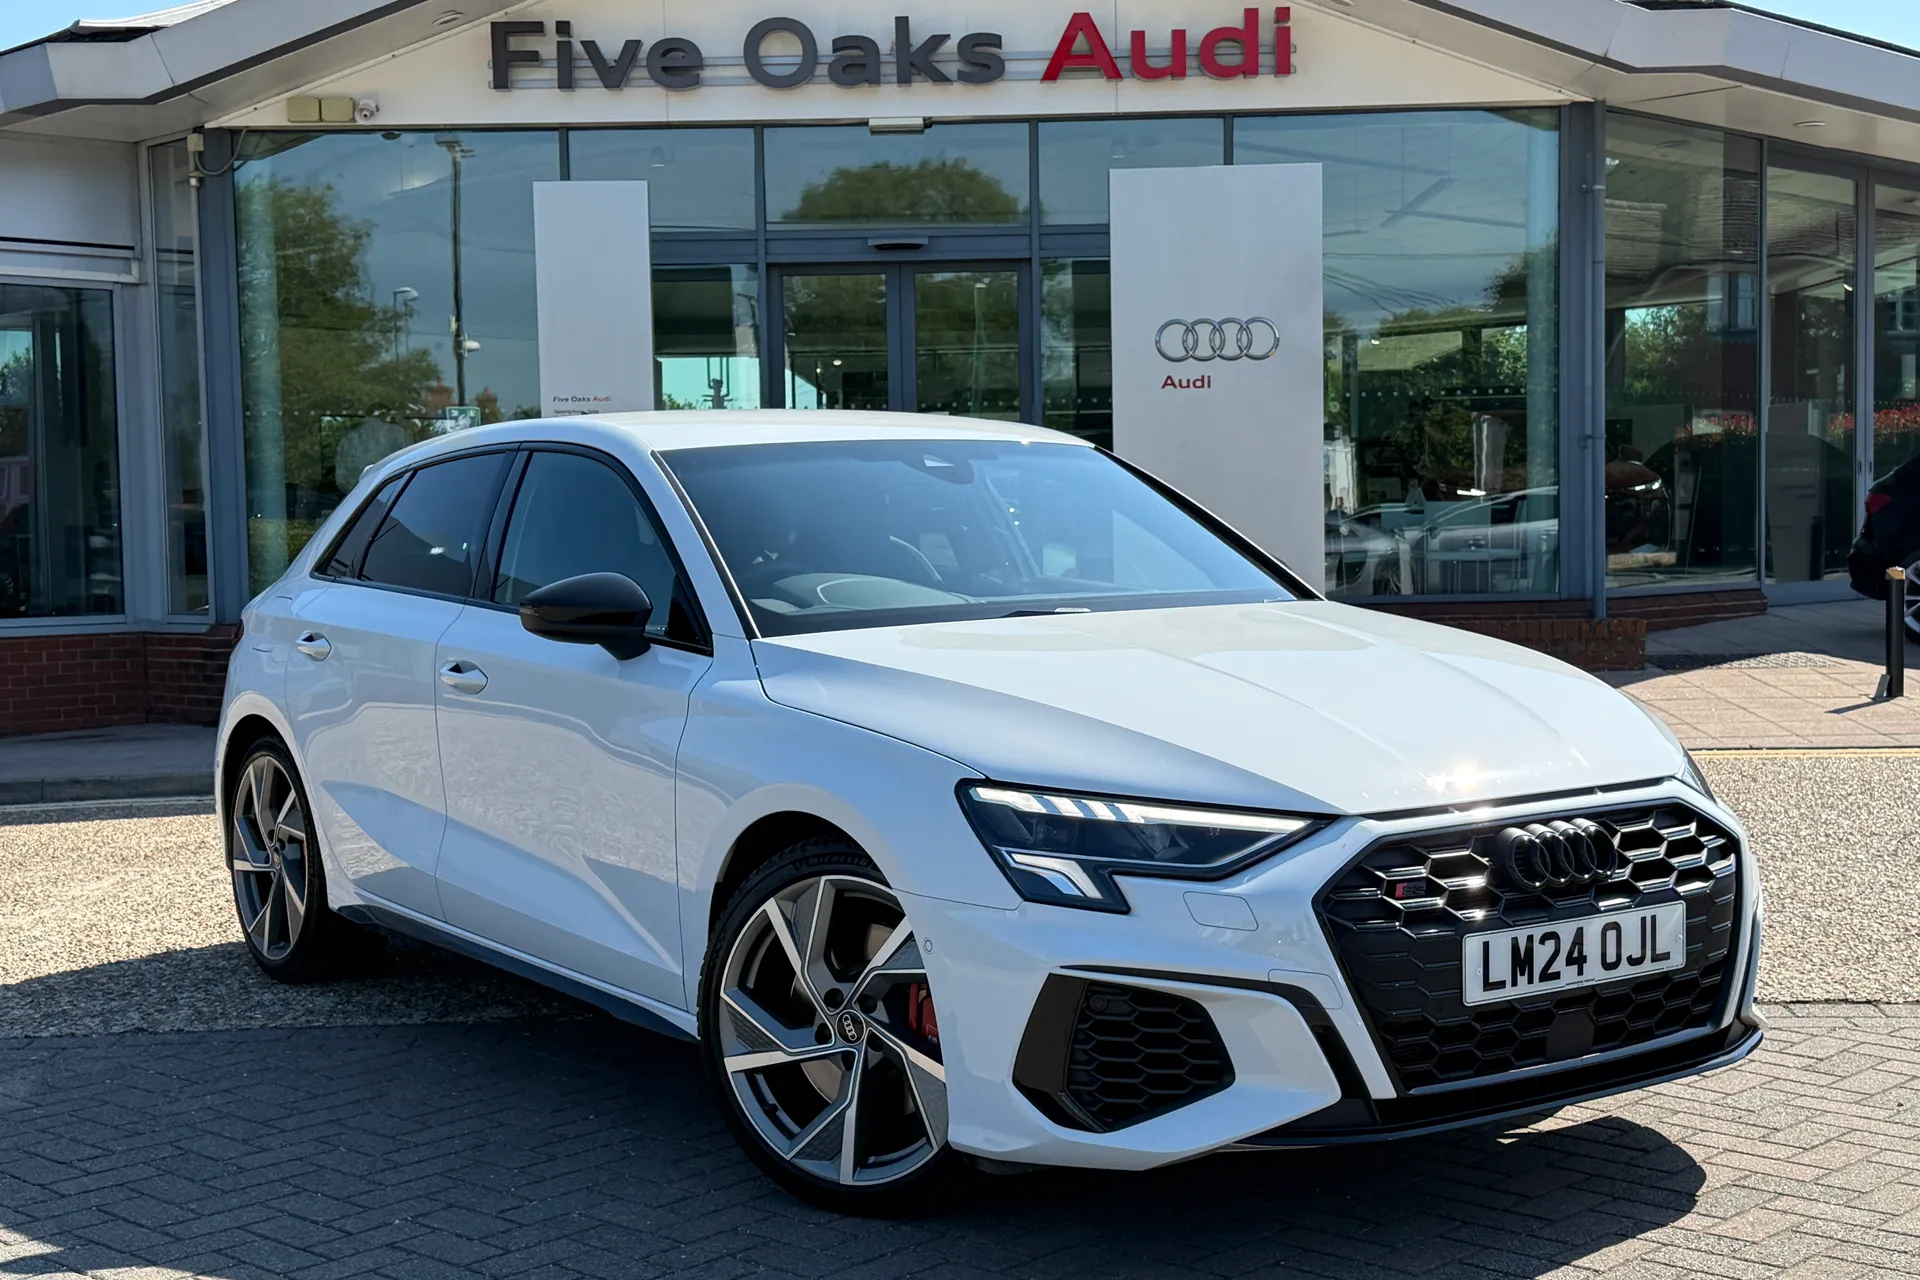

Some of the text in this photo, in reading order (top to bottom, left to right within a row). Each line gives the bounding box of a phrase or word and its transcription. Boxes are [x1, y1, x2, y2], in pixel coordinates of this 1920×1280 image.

[491, 7, 1291, 91] Five Oaks Audi
[1161, 375, 1211, 389] Audi
[1482, 914, 1671, 992] LM24 OJL
